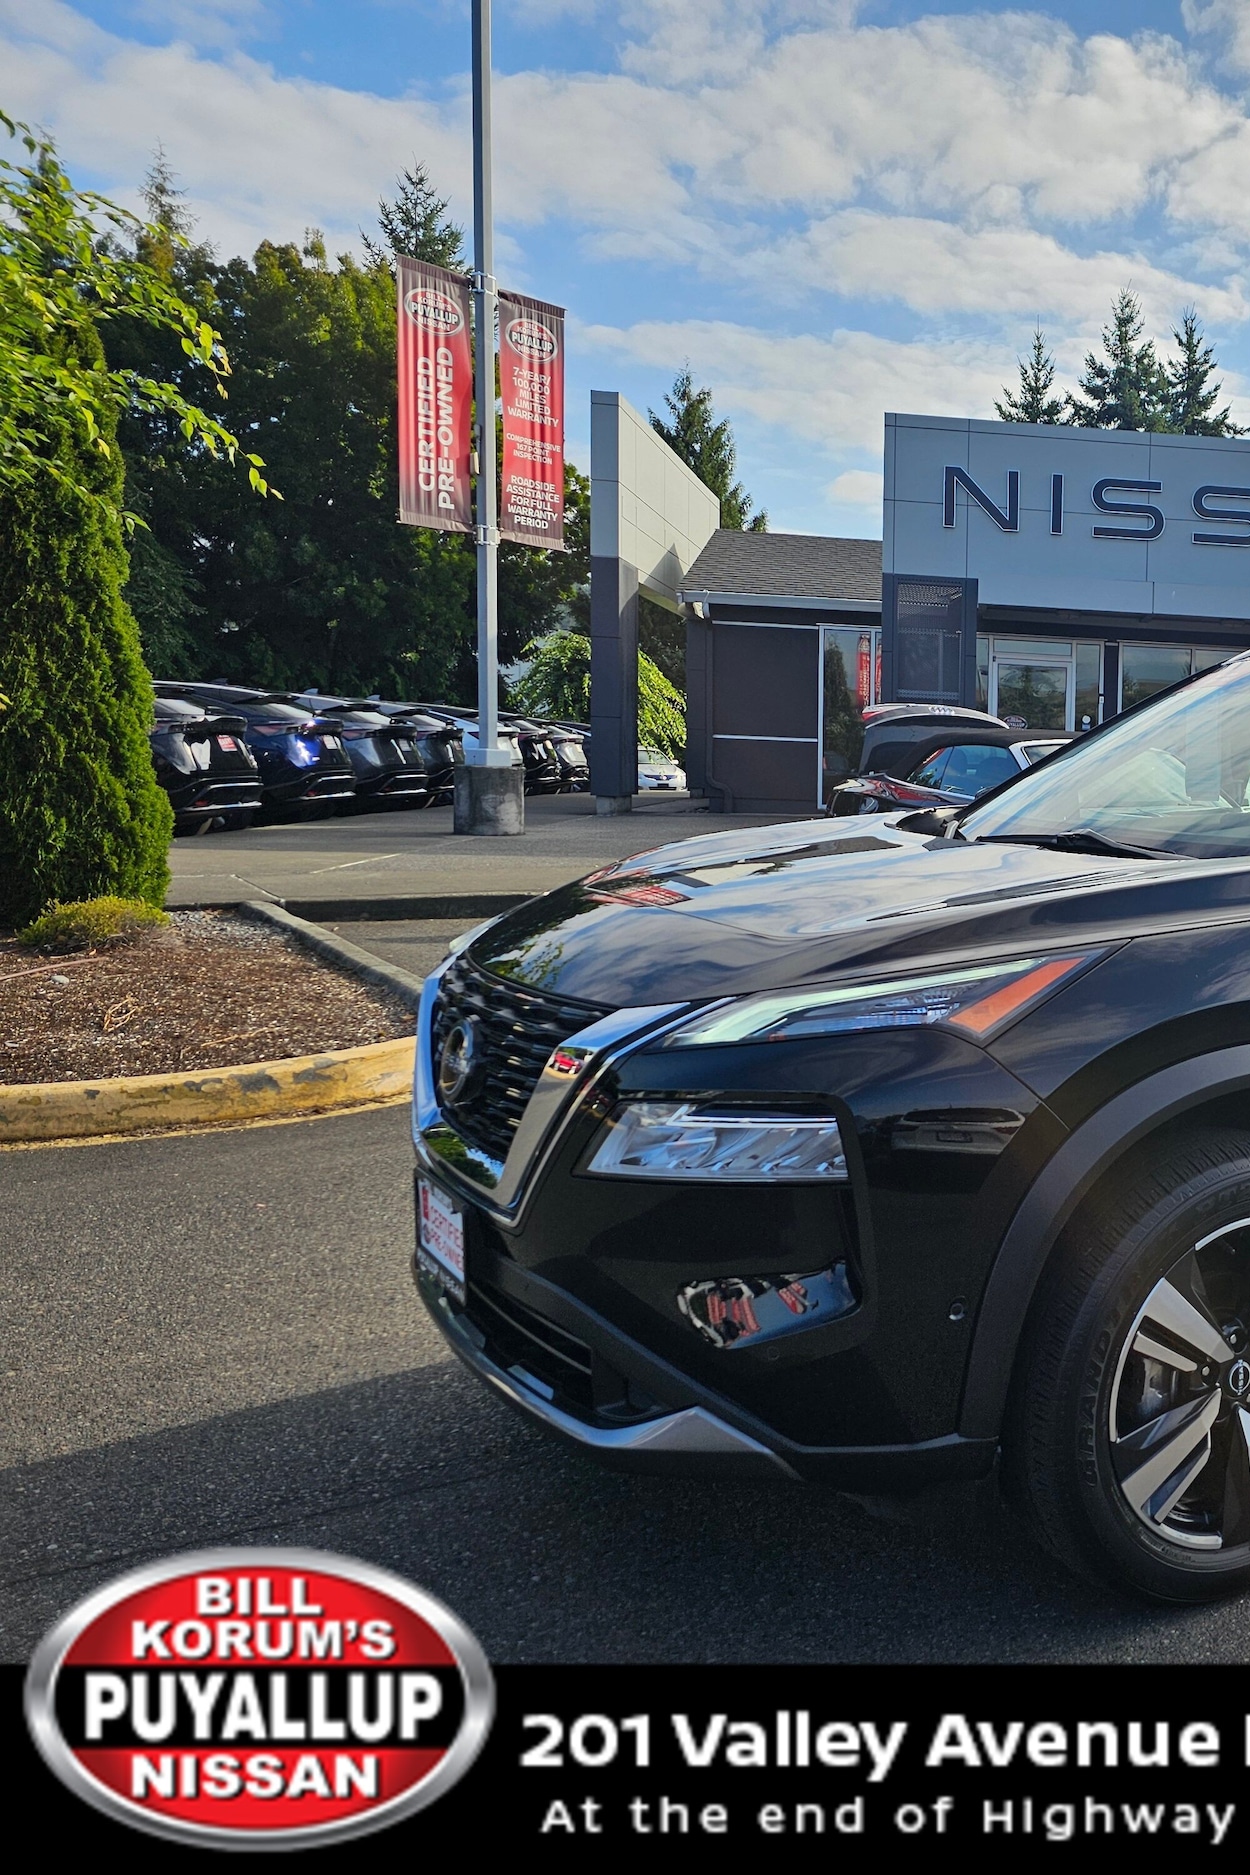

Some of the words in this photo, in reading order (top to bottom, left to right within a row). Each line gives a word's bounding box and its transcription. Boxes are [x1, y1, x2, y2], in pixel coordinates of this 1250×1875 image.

[411, 301, 458, 324] PUYALLUP
[418, 315, 450, 331] NISSAN
[511, 331, 553, 352] PUYALLUP
[518, 344, 546, 358] NISSAN
[513, 366, 551, 385] 7-YEAR/
[512, 377, 550, 395] 100,000
[519, 389, 546, 404] MILES
[515, 398, 551, 415] LIMITED
[417, 356, 434, 491] CERTIFIED
[507, 406, 559, 427] WARRANTY
[437, 347, 455, 510] PRE-OWNED
[506, 432, 561, 452] COMPREHENSIVE
[513, 450, 552, 465] INSPECTION
[527, 446, 550, 457] POINT
[511, 475, 555, 493] ROADSIDE
[506, 484, 560, 503] ASSISTANCE
[508, 504, 558, 521] WARRANTY
[511, 495, 530, 507] FOR
[531, 498, 553, 512] FULL
[514, 515, 549, 529] PERIOD
